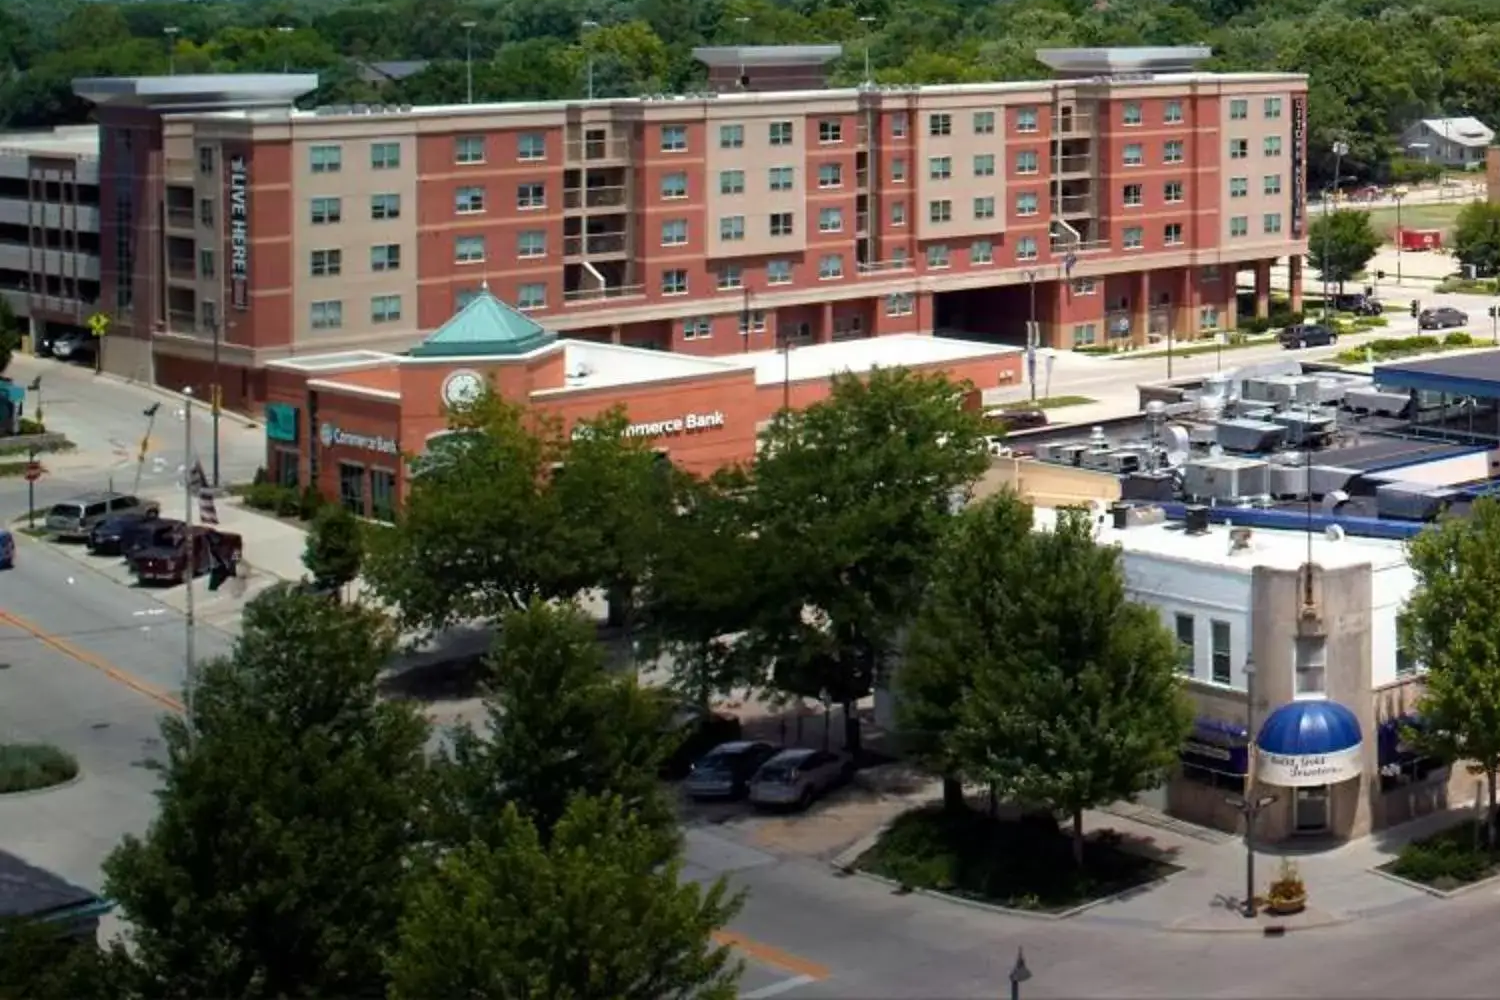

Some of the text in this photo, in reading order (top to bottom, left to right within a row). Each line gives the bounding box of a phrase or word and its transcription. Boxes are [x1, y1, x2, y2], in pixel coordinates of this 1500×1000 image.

[231, 173, 247, 215] LIVE
[614, 411, 724, 437] mmerce Bank
